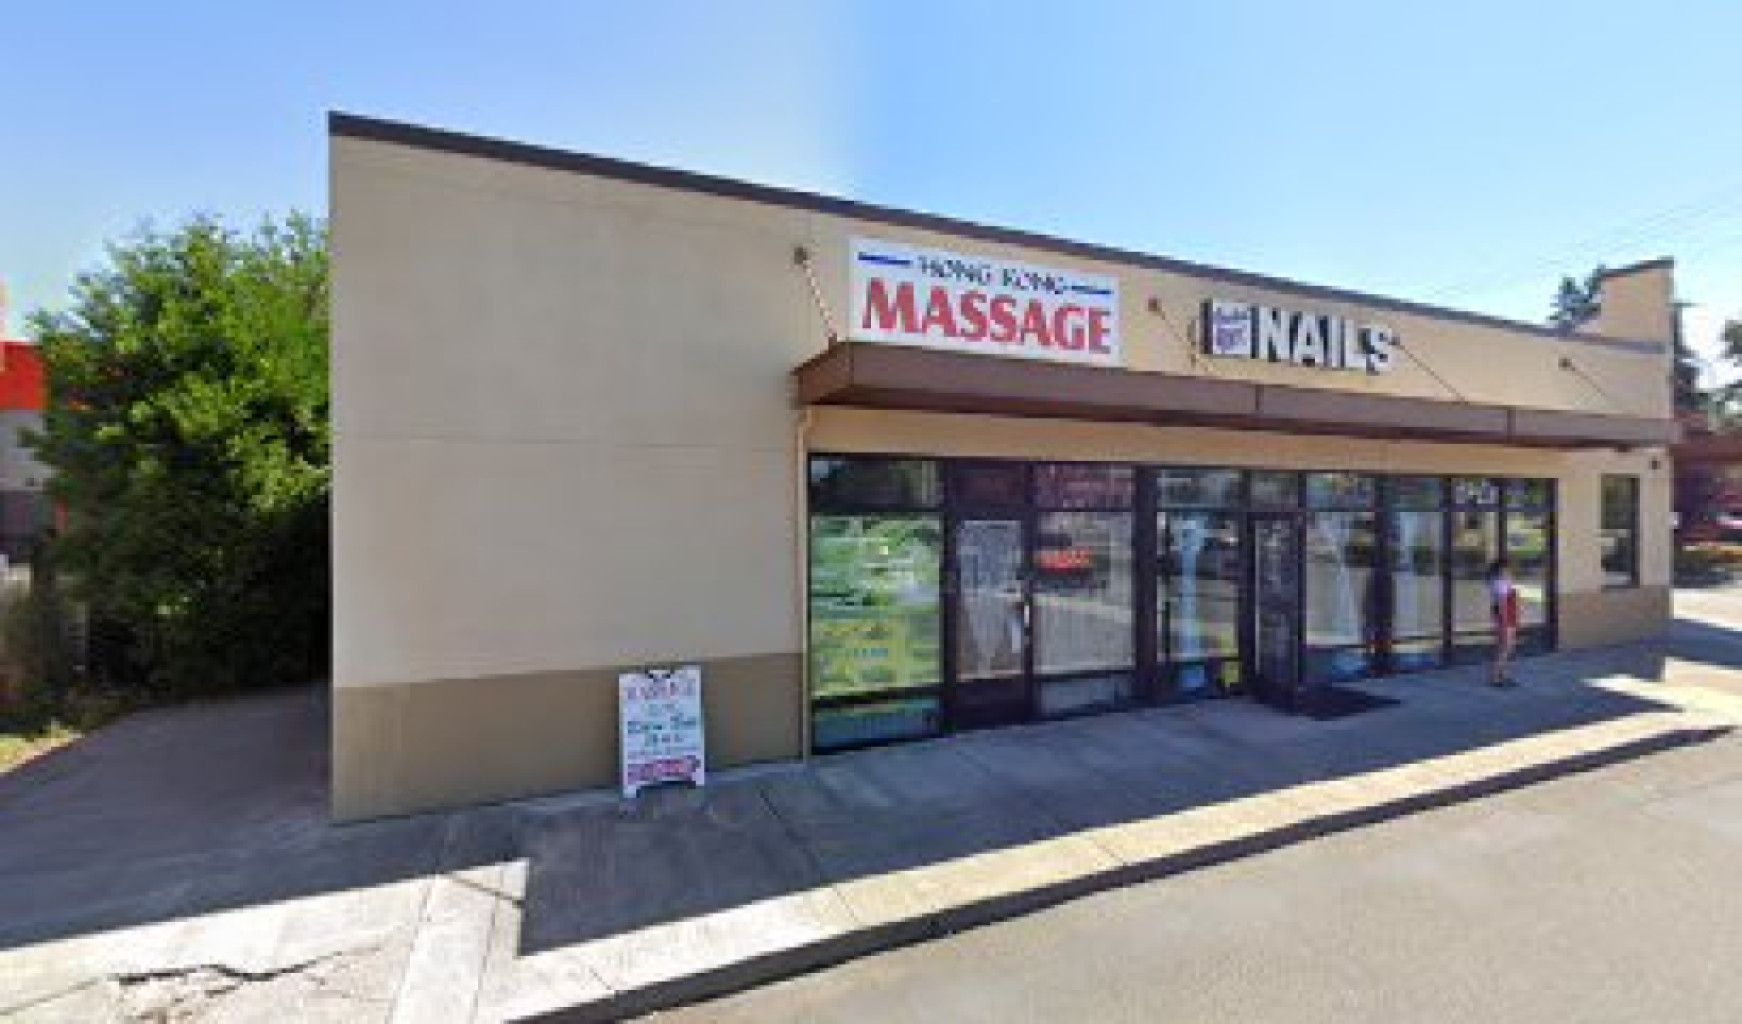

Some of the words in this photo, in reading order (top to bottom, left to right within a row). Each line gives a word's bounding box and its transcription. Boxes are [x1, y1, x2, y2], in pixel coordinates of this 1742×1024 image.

[919, 255, 990, 286] HONG
[1003, 268, 1064, 295] KONG
[862, 277, 1111, 355] MASSAGE
[1257, 306, 1396, 373] NAILS
